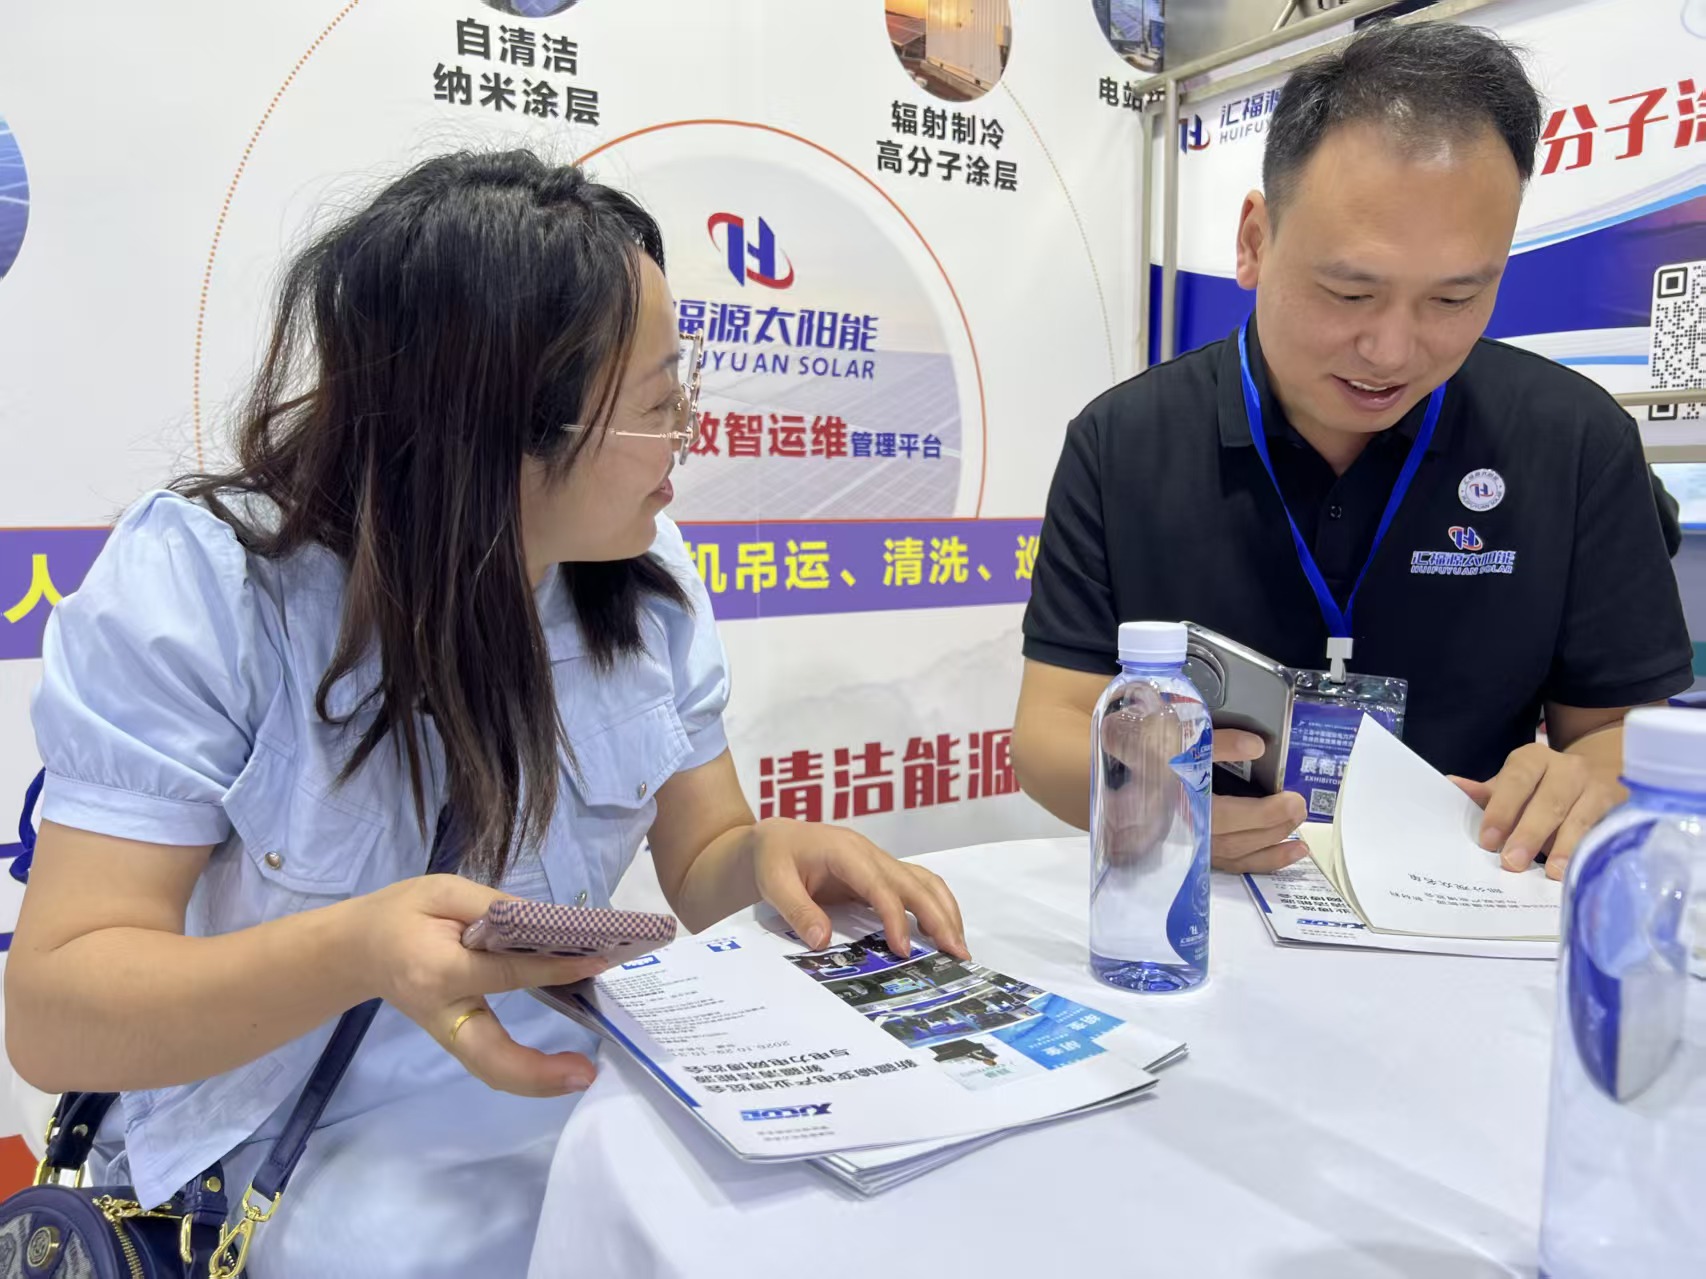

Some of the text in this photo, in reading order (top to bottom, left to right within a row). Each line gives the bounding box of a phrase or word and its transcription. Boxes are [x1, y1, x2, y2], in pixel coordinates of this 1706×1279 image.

[456, 18, 578, 76] 自清洁
[433, 62, 600, 126] 纳米涂层
[1099, 76, 1165, 113] 电站
[891, 100, 1004, 150] 辐射制冷
[876, 140, 1017, 191] 高分子涂层
[798, 356, 875, 379] SOLAR
[851, 431, 942, 459] 管理平台
[1411, 550, 1516, 567] 汇福源太阳能
[1411, 564, 1513, 576] HUIFUYUAN SOLAR
[3, 553, 64, 624] 人
[759, 728, 1020, 823] 清洁能源
[683, 1048, 851, 1074] 与电力电网博览会
[693, 1063, 824, 1084] 新疆清洁能源
[703, 1059, 920, 1094] 新疆输变电产业博览会
